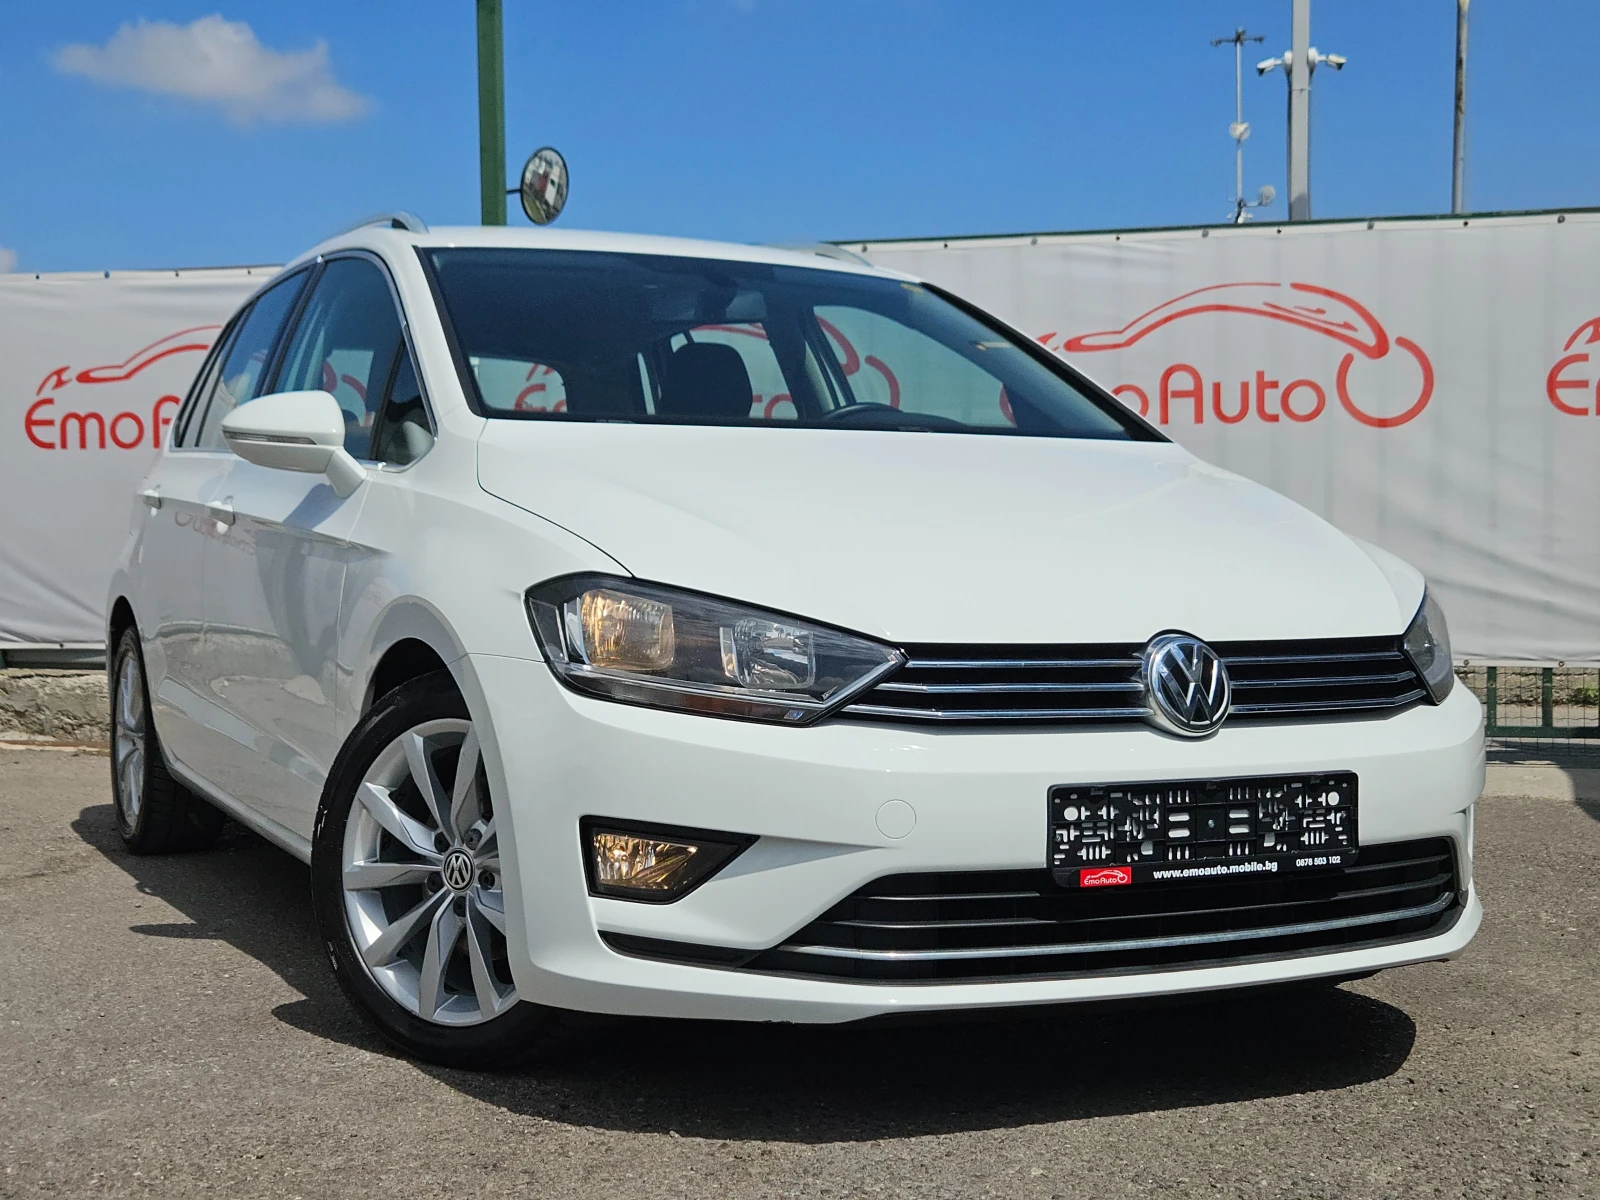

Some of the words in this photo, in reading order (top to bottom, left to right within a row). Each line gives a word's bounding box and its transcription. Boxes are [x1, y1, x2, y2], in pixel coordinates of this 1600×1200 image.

[1296, 858, 1313, 867] 0878
[1314, 857, 1327, 866] 503
[1328, 855, 1341, 864] 102
[1153, 860, 1278, 879] www.emoauto.mobile.bg
[1083, 876, 1118, 886] EmoAuto
